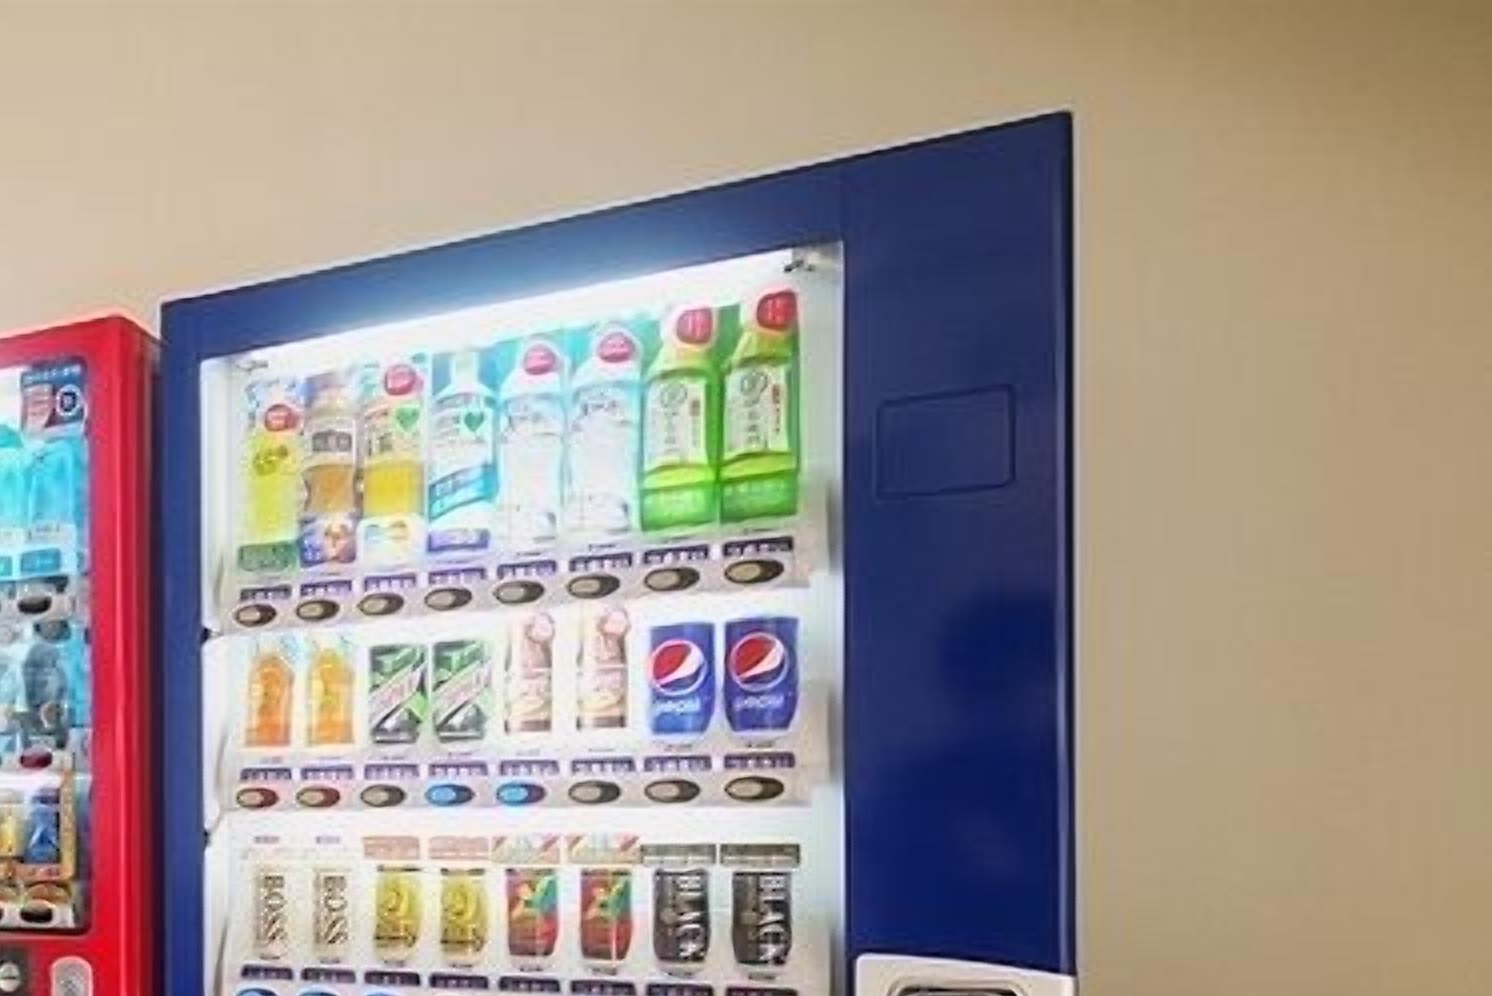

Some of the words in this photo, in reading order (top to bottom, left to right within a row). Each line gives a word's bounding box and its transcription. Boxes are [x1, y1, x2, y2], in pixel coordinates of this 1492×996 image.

[264, 875, 285, 945] BOSS
[323, 875, 348, 945] BOSS
[676, 875, 705, 959] BLACK
[759, 875, 787, 964] BLACK
